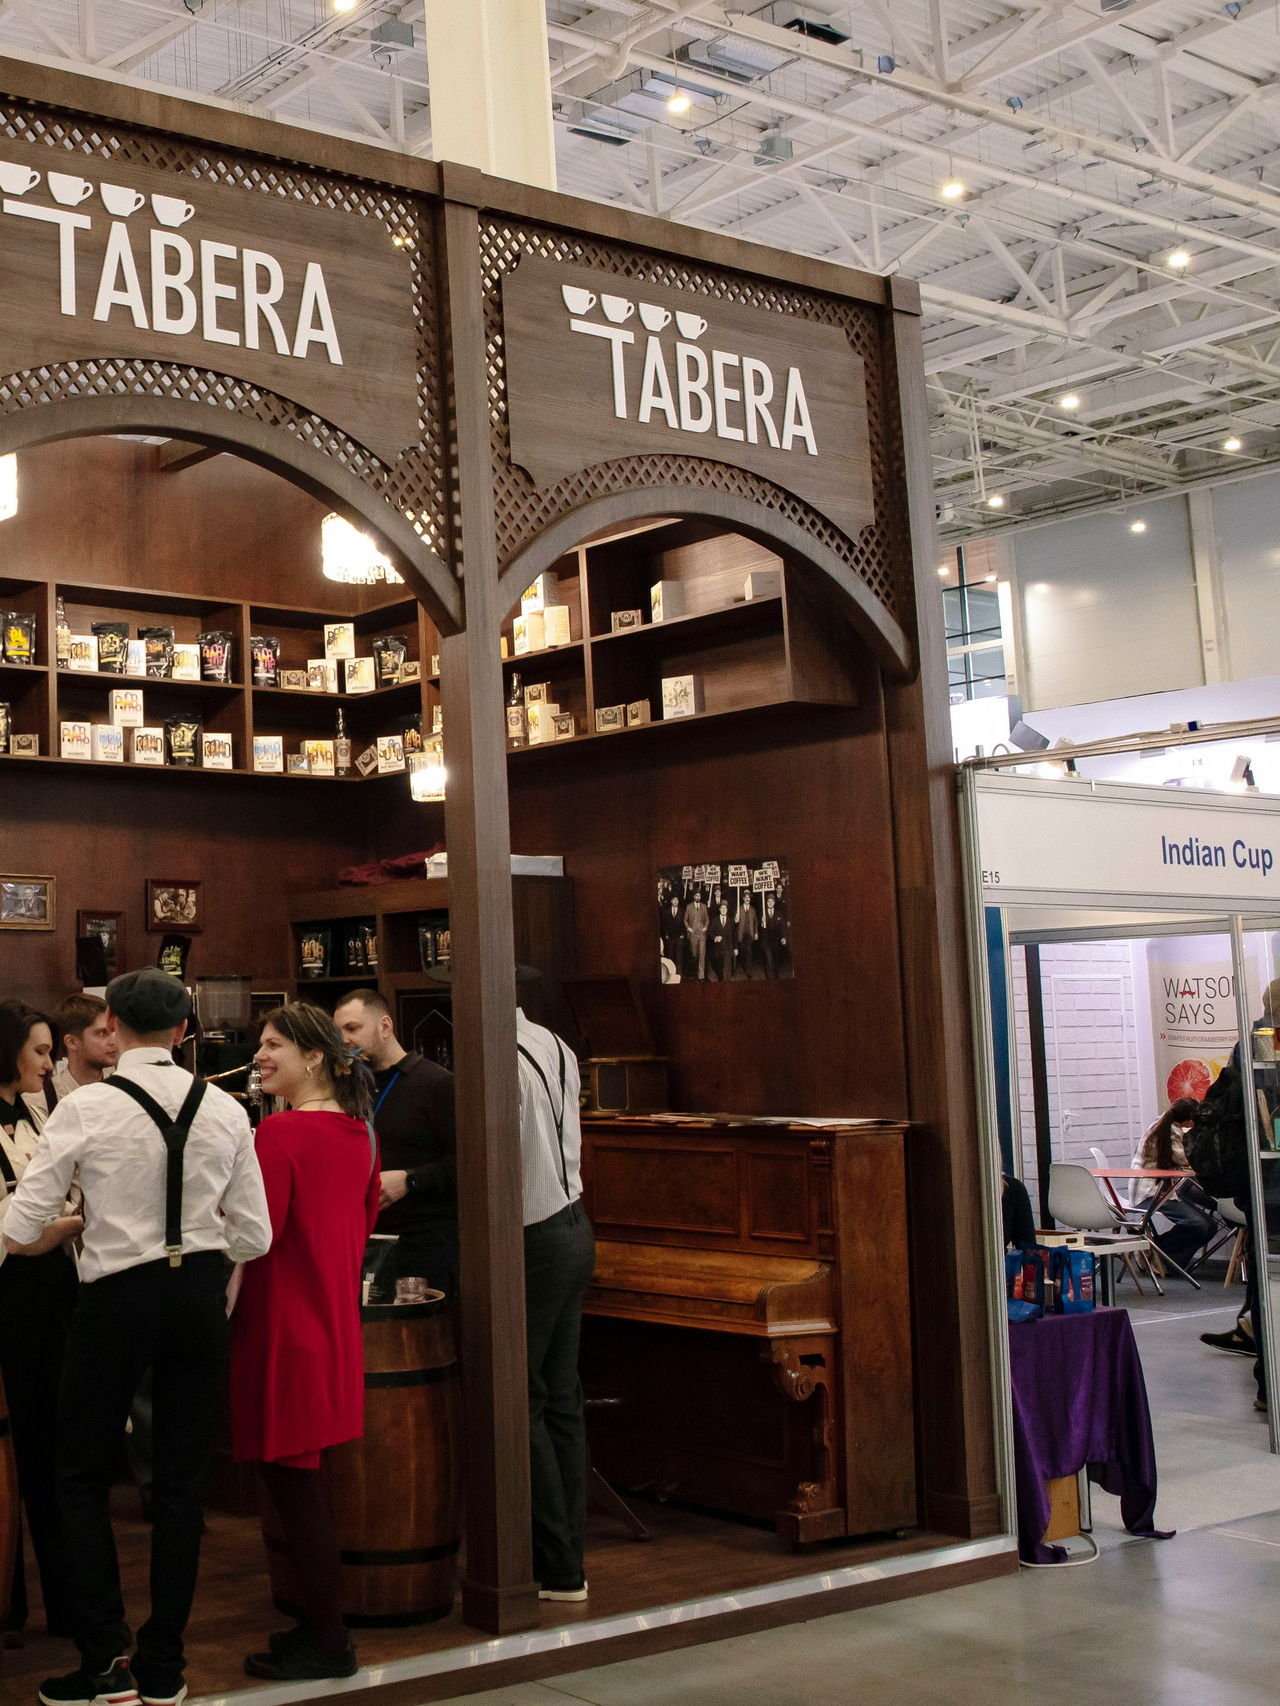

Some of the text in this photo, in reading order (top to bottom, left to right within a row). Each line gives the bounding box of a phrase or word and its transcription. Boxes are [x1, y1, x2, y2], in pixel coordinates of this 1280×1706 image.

[3, 199, 343, 366] TABERA
[570, 318, 818, 456] TABERA
[1161, 835, 1274, 876] Indian Cup
[730, 877, 748, 885] COFFEE
[754, 881, 773, 890] COFFEE
[982, 870, 1001, 884] E15
[1165, 1002, 1215, 1025] SAYS
